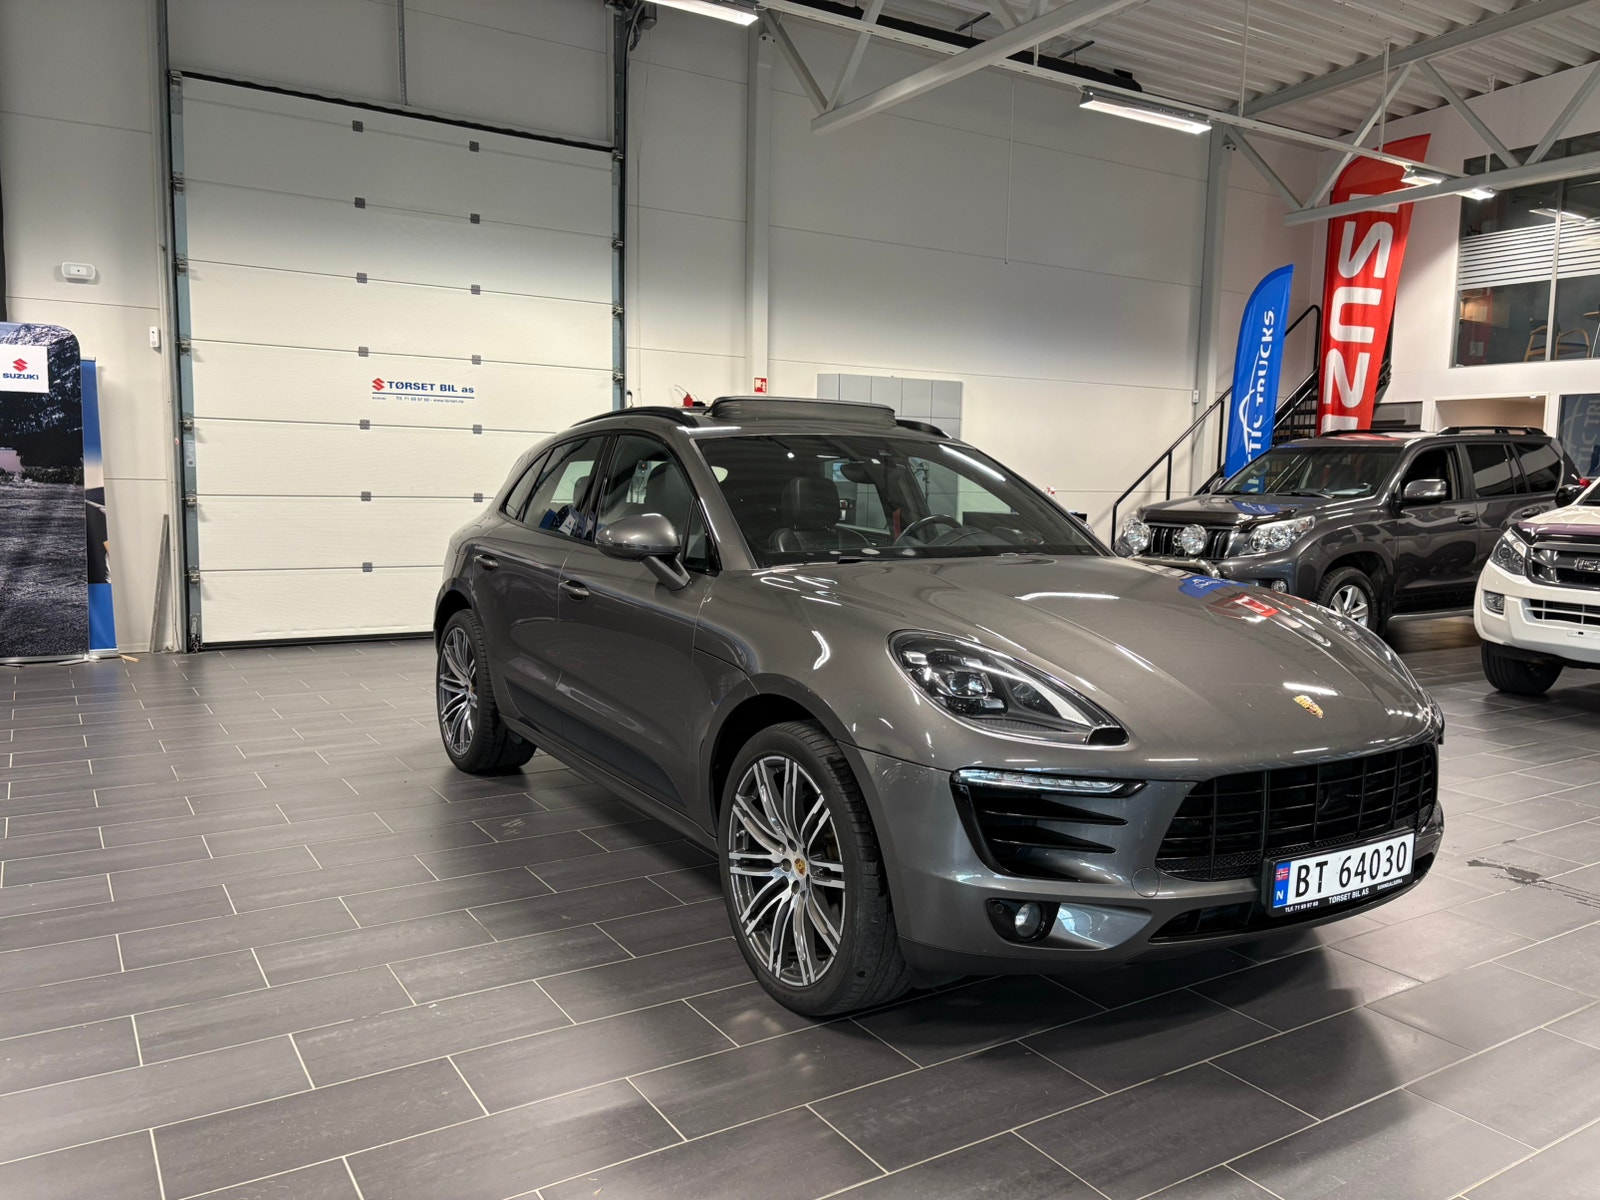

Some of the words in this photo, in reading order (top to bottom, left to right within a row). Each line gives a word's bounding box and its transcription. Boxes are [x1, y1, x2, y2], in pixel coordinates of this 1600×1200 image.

[1254, 310, 1275, 407] TRUCKS
[387, 381, 436, 391] TØRSET
[440, 384, 458, 392] BIL
[1295, 860, 1329, 898] BT
[1339, 841, 1407, 888] 64030
[1276, 889, 1284, 900] N
[1328, 892, 1351, 904] TØRSET
[1351, 890, 1361, 898] BIL
[1362, 887, 1370, 896] AS
